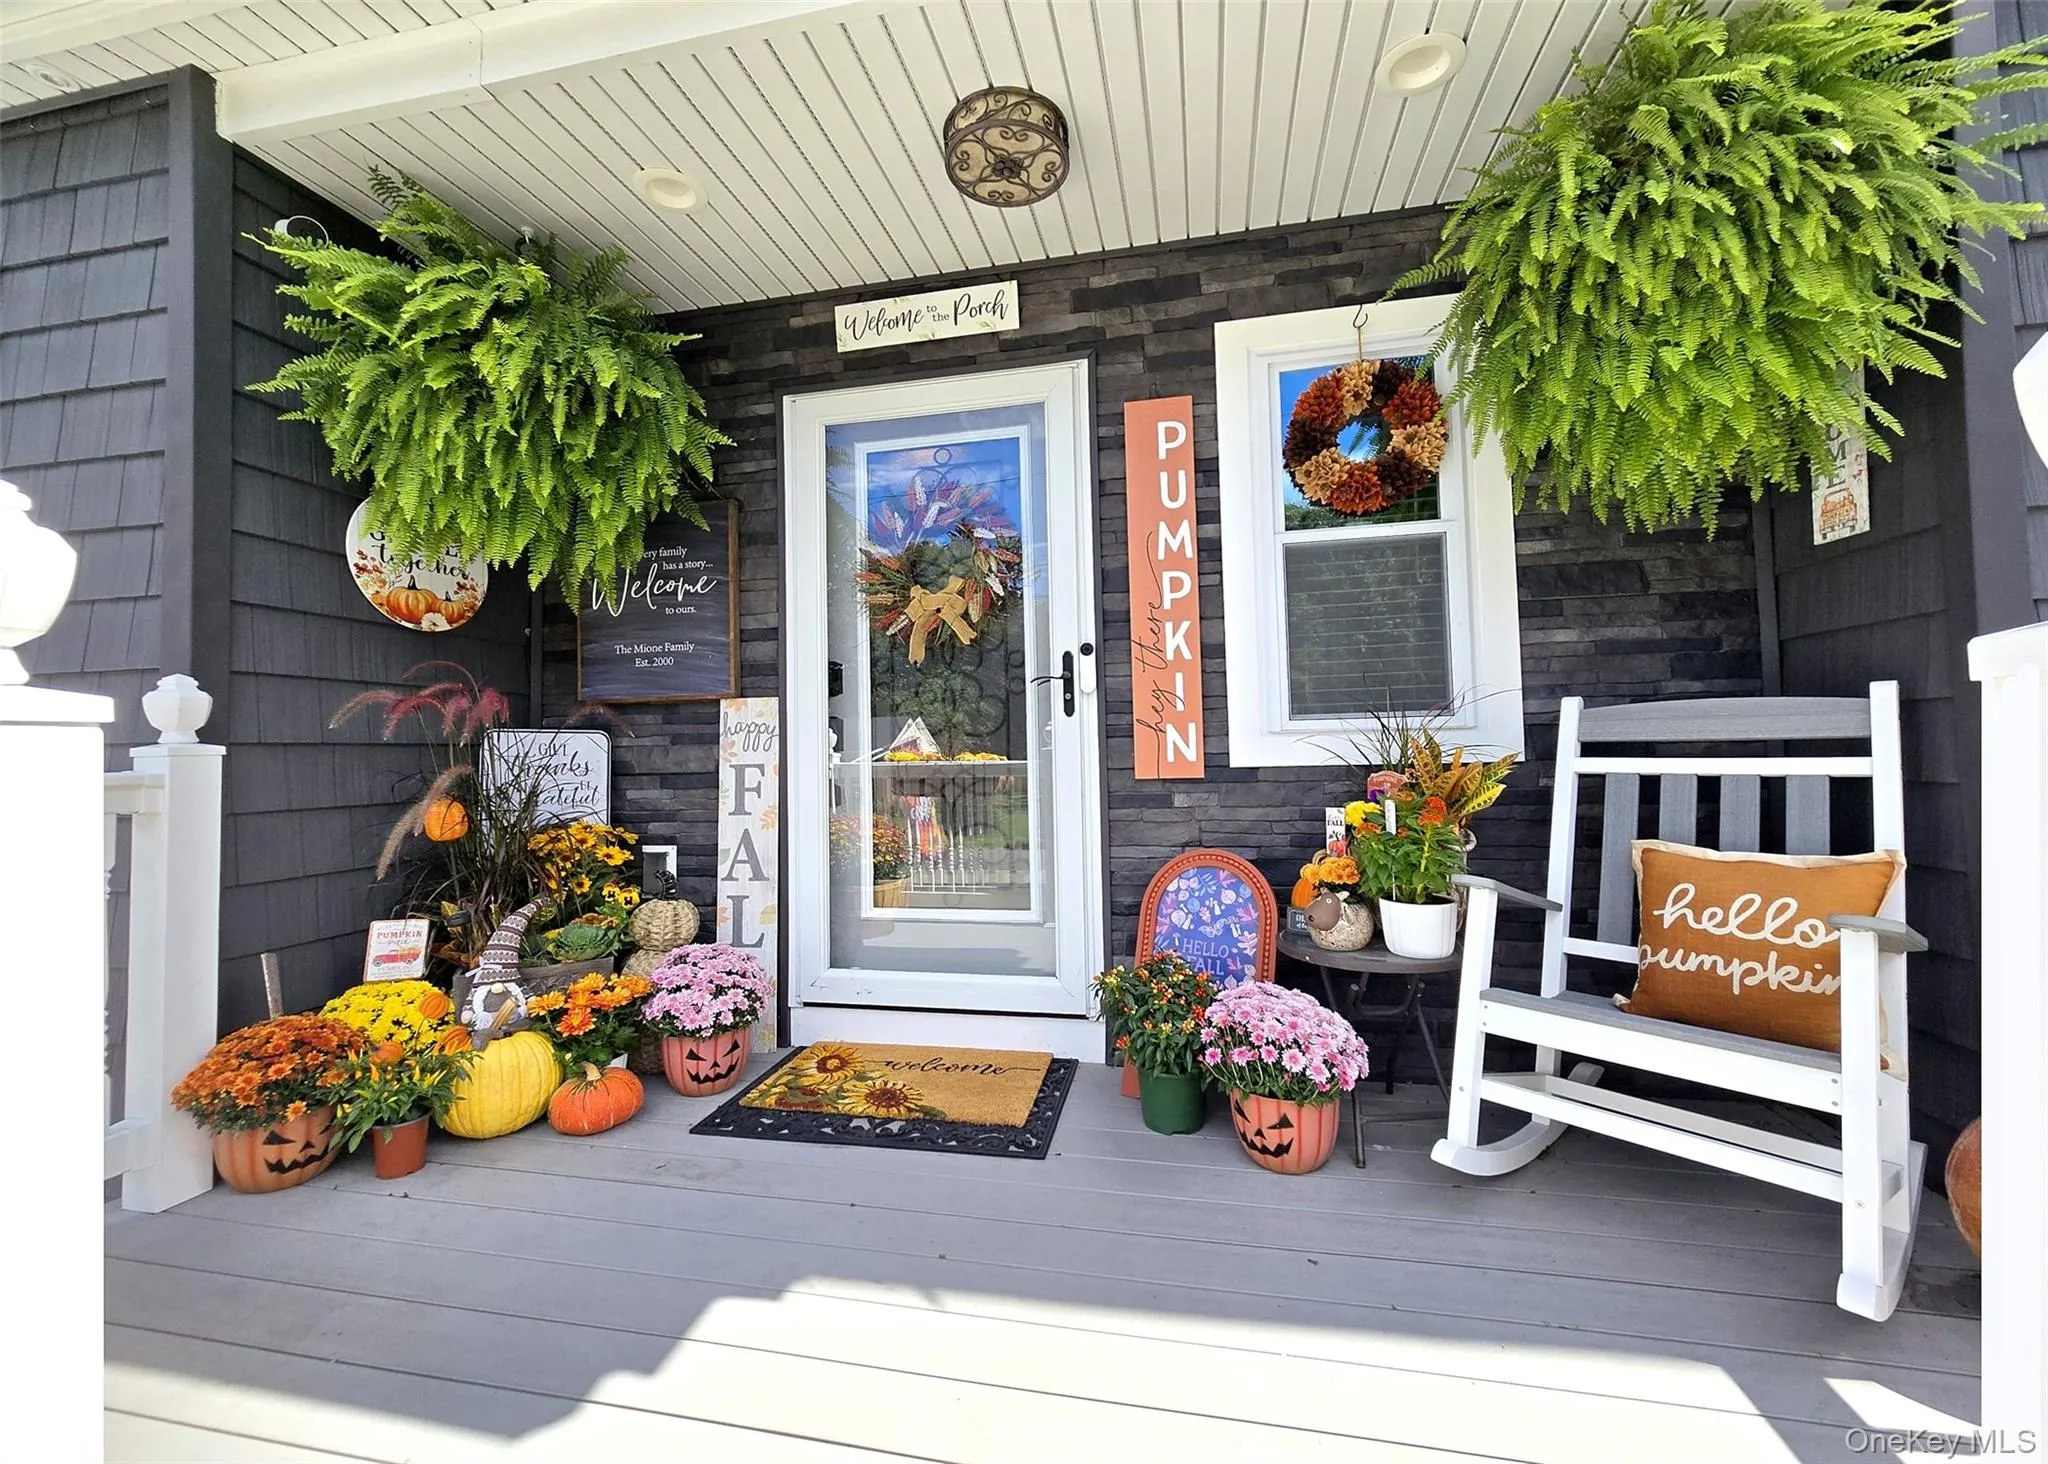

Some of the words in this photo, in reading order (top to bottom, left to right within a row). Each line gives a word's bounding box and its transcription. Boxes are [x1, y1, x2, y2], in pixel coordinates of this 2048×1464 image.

[844, 307, 924, 341] Welcome
[926, 304, 937, 313] to
[932, 312, 950, 322] the
[953, 289, 1009, 326] Porch
[659, 546, 687, 558] family
[662, 561, 677, 570] has
[678, 561, 684, 569] a
[592, 563, 717, 617] Welcome
[1156, 420, 1198, 764] PUMPKIN
[665, 606, 675, 615] to
[676, 606, 697, 614] ours.
[614, 644, 632, 654] The
[634, 642, 662, 654] Mione
[664, 640, 695, 653] Family
[635, 658, 651, 667] Est.
[653, 656, 674, 667] 2000
[720, 712, 779, 752] happy
[1136, 680, 1184, 768] hey
[1653, 883, 1840, 949] hello
[1182, 938, 1230, 959] HELLO
[868, 1056, 1037, 1076] welcome
